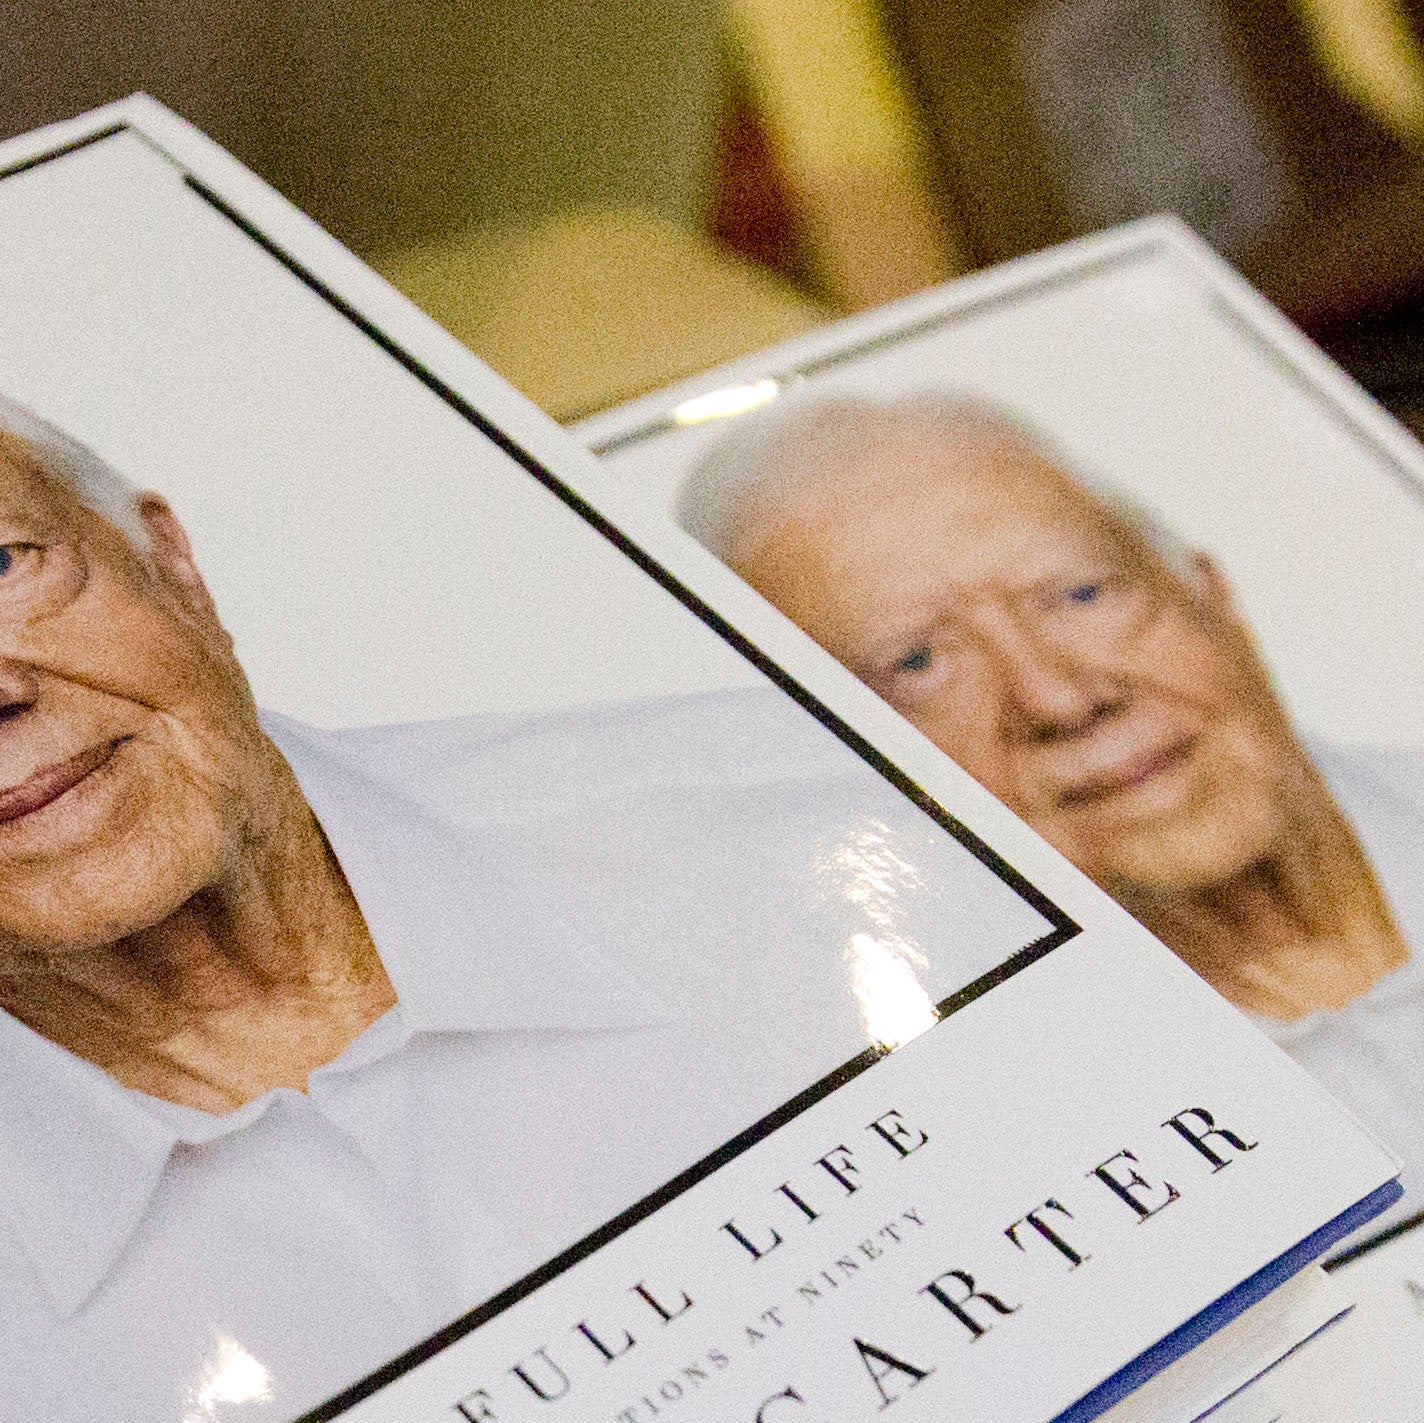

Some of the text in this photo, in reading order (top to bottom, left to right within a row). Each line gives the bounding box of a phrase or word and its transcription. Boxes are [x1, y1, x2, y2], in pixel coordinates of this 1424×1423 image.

[719, 1109, 929, 1261] LIFE
[743, 1305, 788, 1349] AT
[793, 1206, 928, 1308] NINETY
